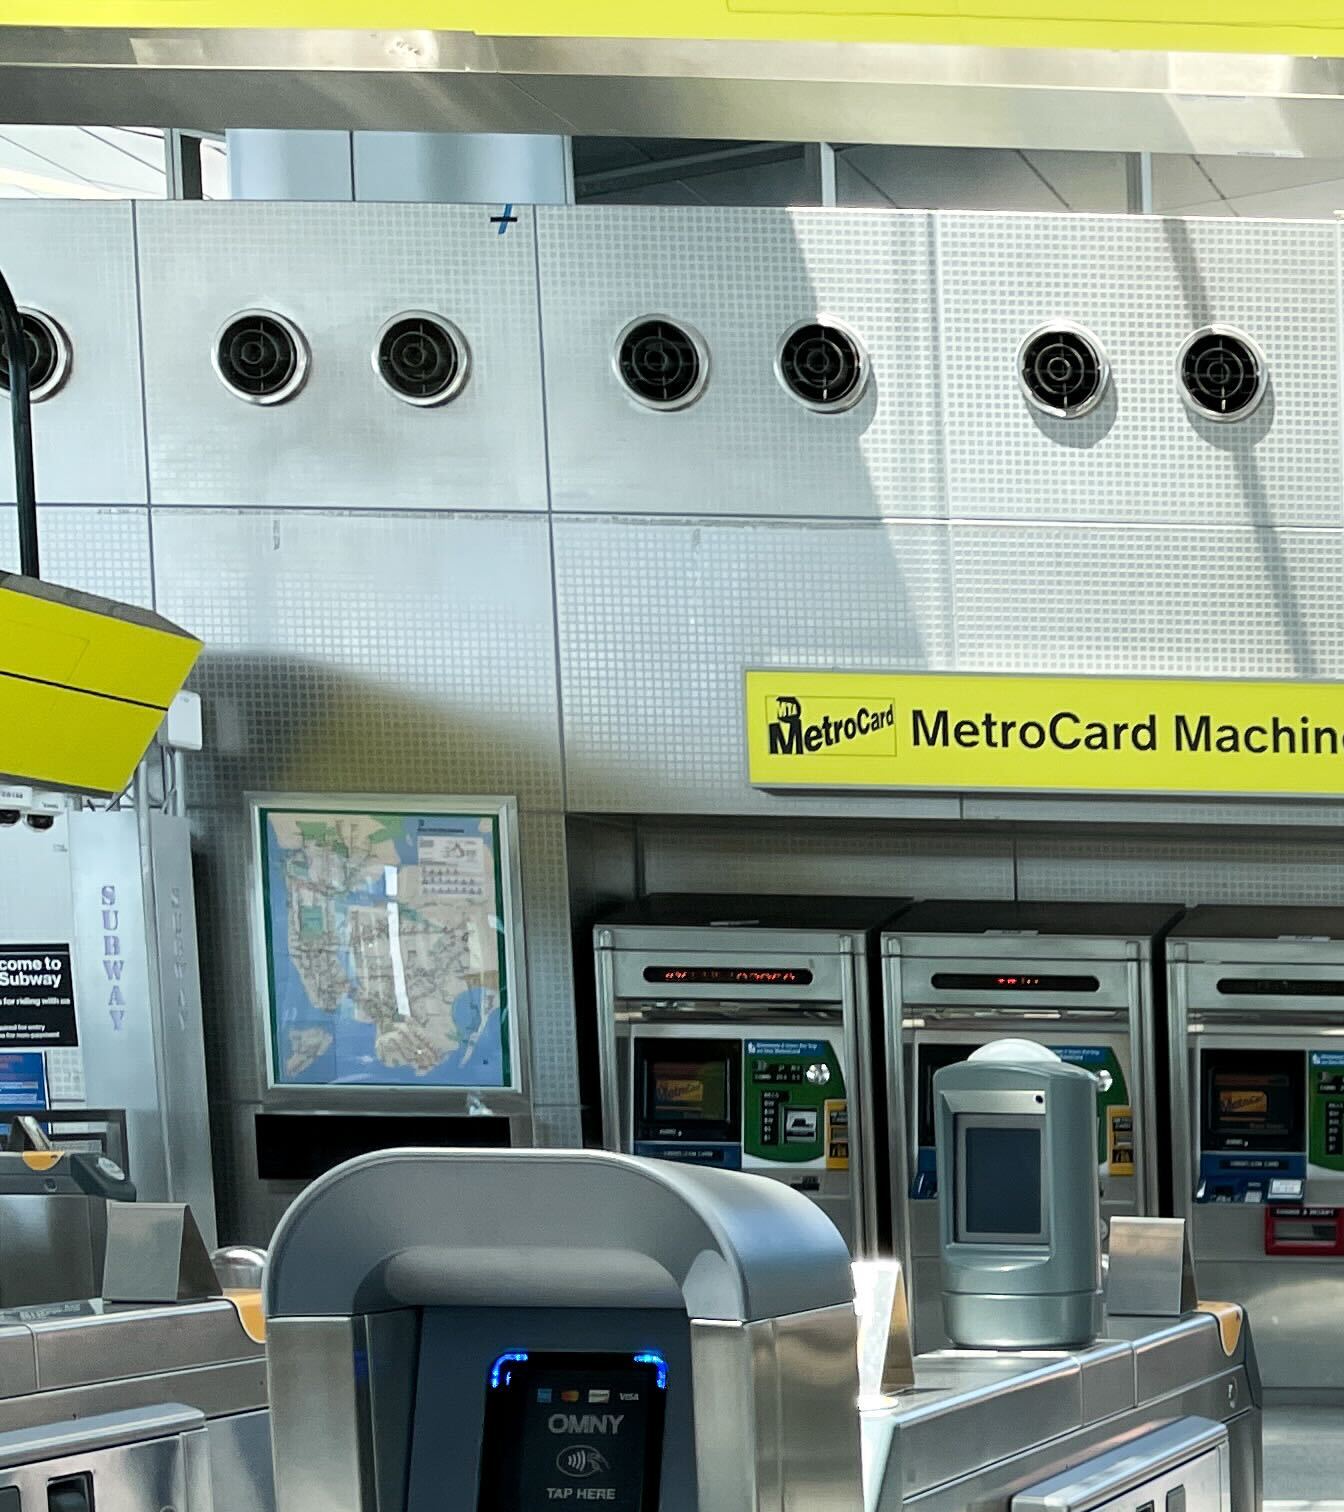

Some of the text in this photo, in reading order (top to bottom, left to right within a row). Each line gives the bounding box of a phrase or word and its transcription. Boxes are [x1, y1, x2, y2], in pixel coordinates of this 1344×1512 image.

[769, 703, 894, 755] MetroCard
[912, 709, 1158, 752] MetroCard
[44, 955, 62, 971] to
[101, 884, 126, 1031] SUBWAY
[0, 971, 62, 989] Subway
[548, 1413, 625, 1435] OMNY
[546, 1487, 617, 1500] TAP HERE
